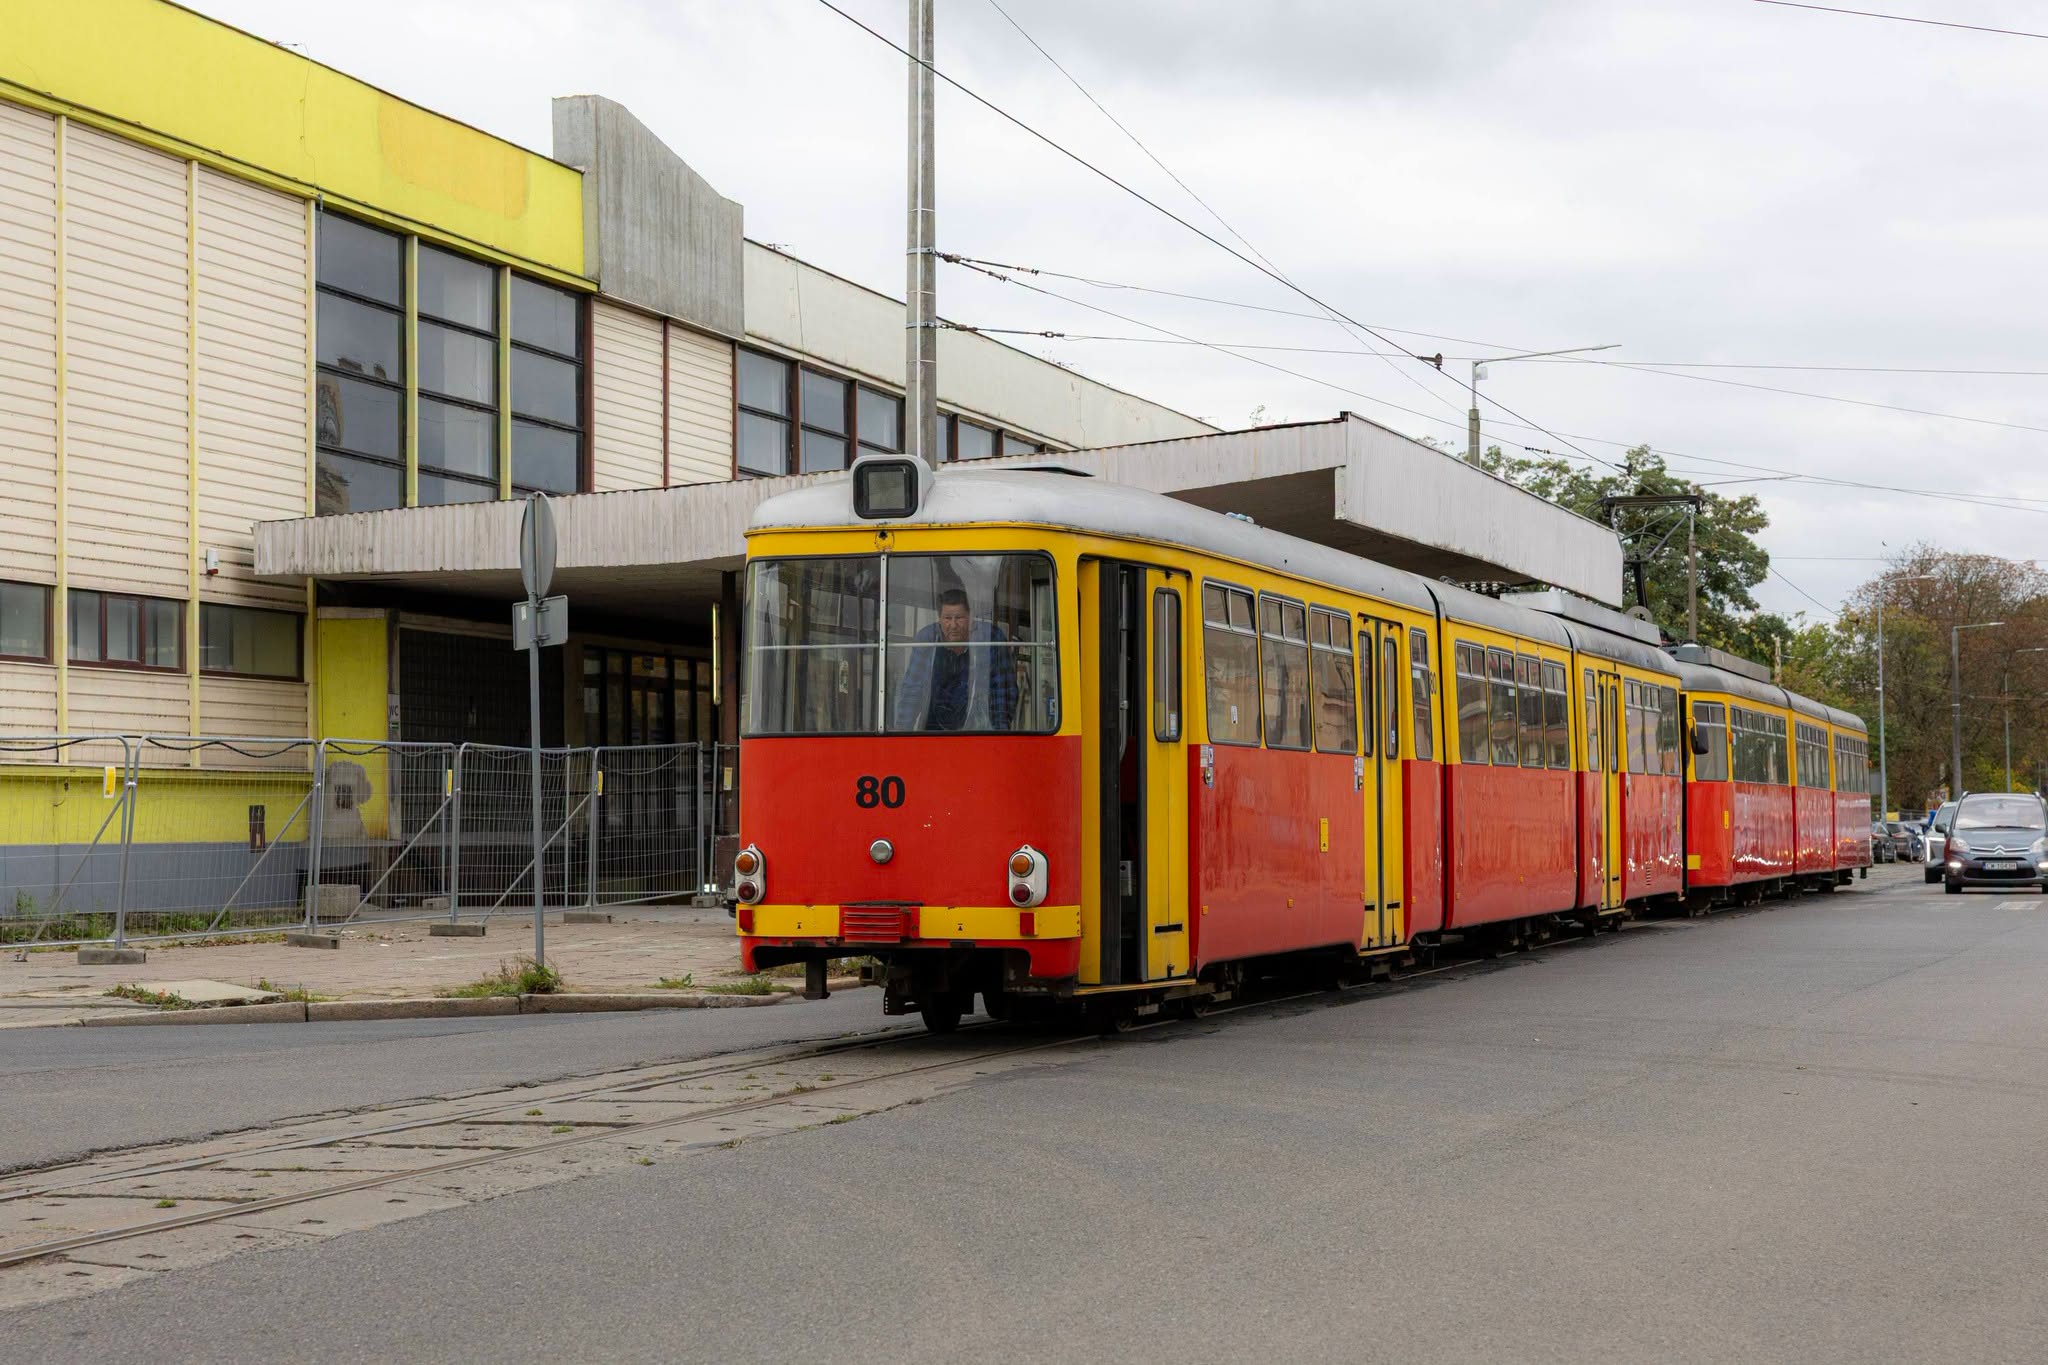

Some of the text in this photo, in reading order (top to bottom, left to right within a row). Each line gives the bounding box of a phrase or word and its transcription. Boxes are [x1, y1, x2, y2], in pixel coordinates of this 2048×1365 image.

[1430, 671, 1437, 695] 80
[389, 704, 399, 717] WC
[856, 775, 906, 809] 80
